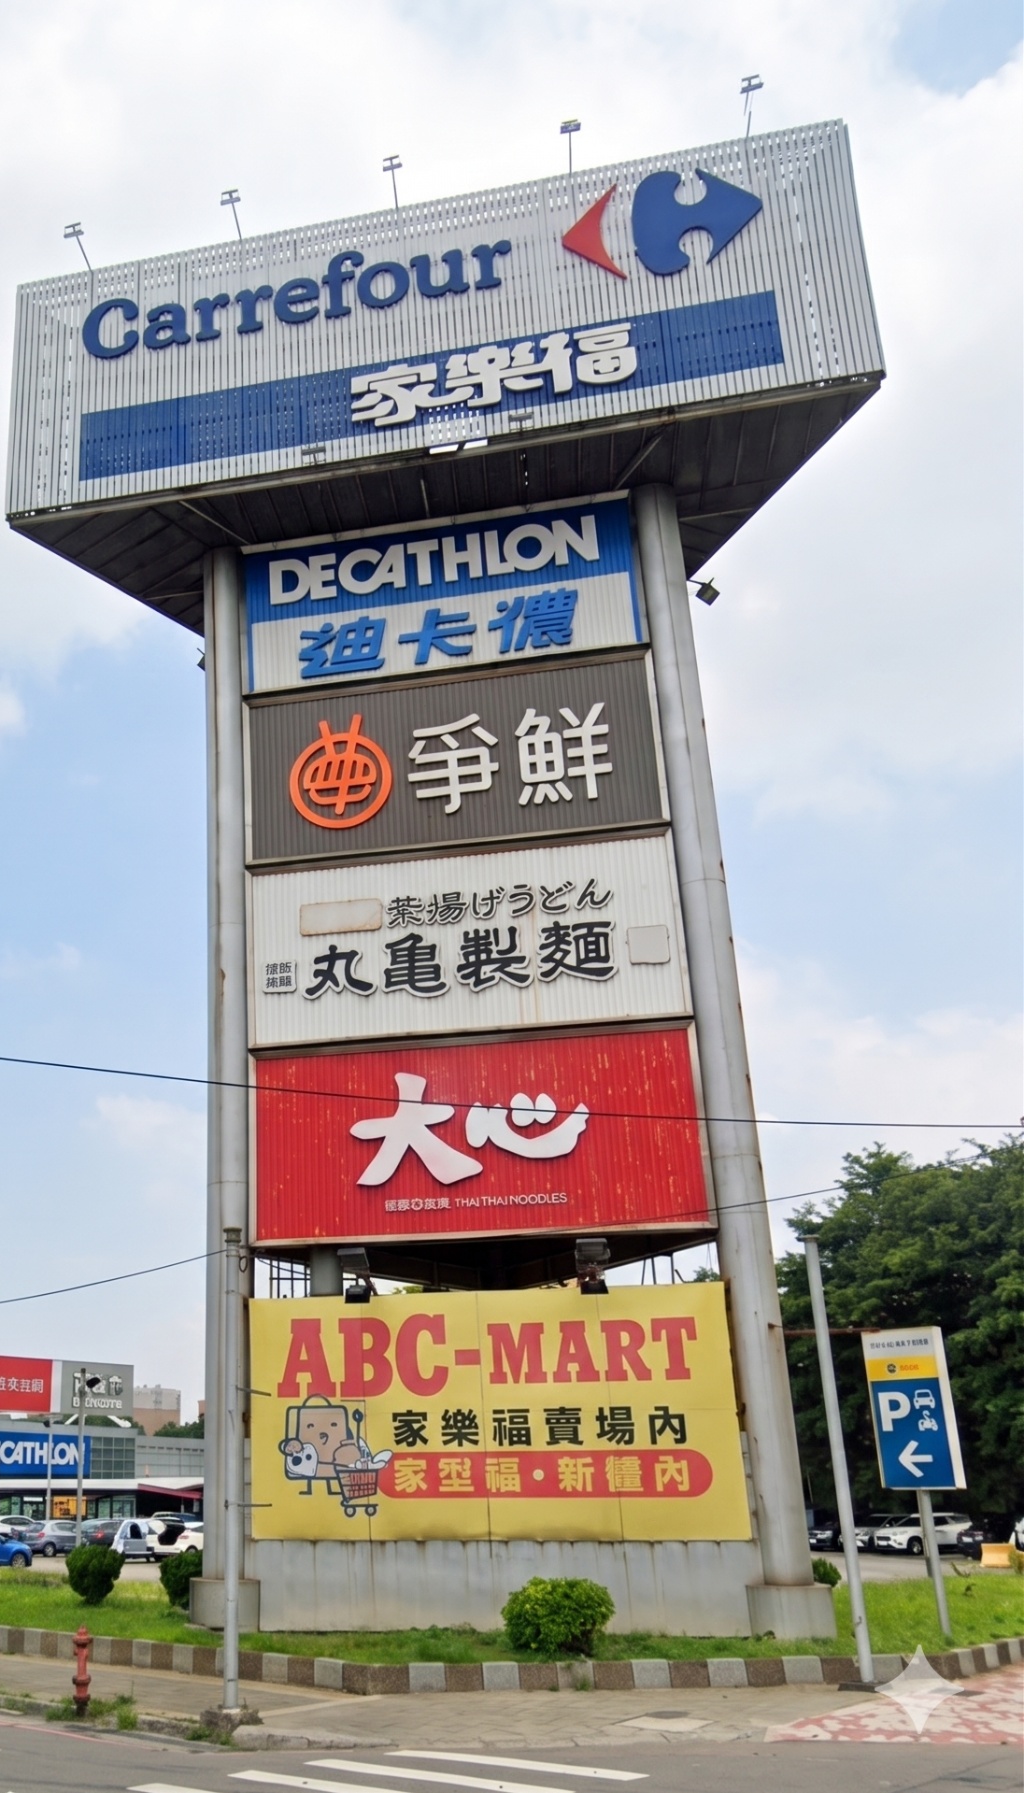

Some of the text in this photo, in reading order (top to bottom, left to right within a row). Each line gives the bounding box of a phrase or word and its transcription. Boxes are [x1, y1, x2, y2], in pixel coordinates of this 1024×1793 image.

[82, 239, 512, 359] Carrefour
[350, 322, 637, 428] 家樂福
[268, 514, 600, 605] DECATHLON
[350, 1072, 590, 1186] 大心
[455, 1197, 480, 1207] THAI
[481, 1195, 508, 1206] THAI
[509, 1193, 568, 1205] NOODLES
[276, 1313, 698, 1398] ABC-MART
[392, 1406, 688, 1447] 家樂福賣場內
[878, 1391, 912, 1432] P
